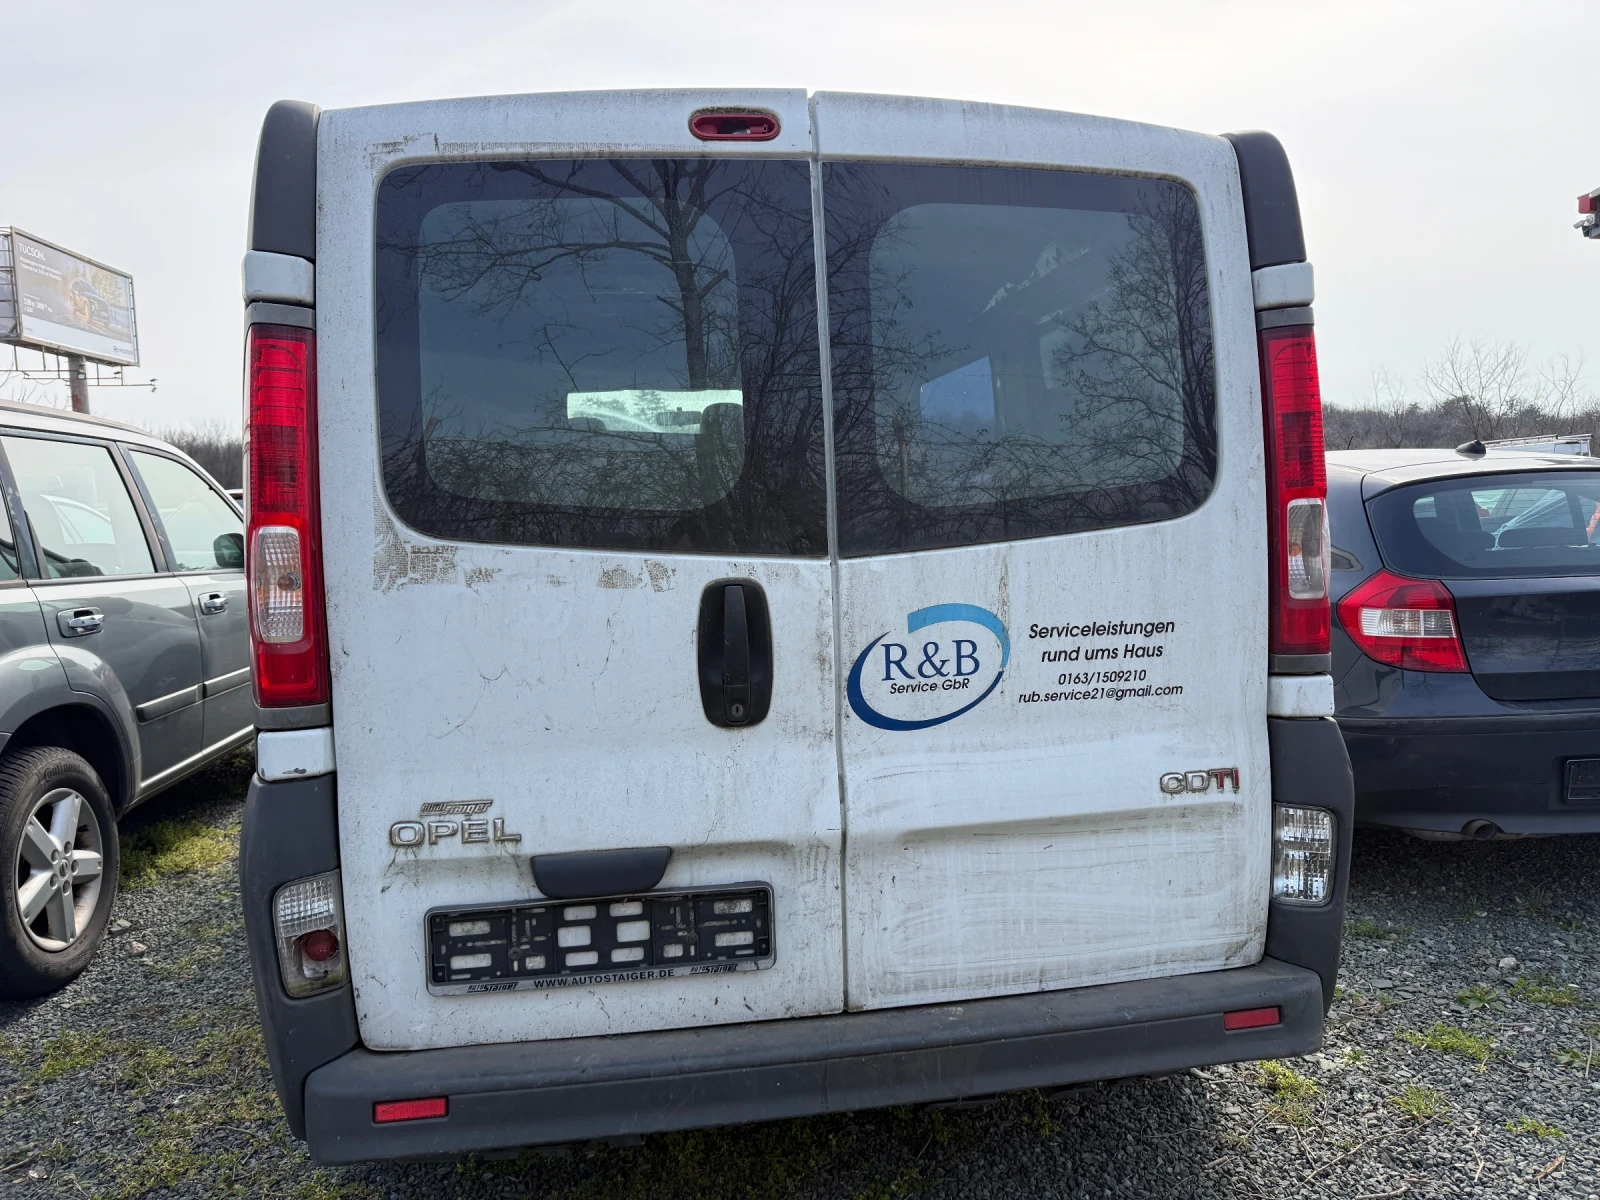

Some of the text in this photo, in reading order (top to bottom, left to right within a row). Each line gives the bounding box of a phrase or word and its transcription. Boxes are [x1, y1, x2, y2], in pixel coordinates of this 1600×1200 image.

[1028, 620, 1175, 639] Serviceleistungen
[881, 639, 980, 681] R&B
[1041, 643, 1164, 663] rund ums Haus
[889, 678, 970, 694] Service GbR
[1058, 669, 1147, 686] 0163/1509210
[1018, 685, 1183, 703] rub.service21@gmail.com
[1160, 767, 1240, 794] CDTI
[389, 817, 522, 848] OPEL
[533, 968, 675, 989] WWW.AUTOSTAIGER.DE
